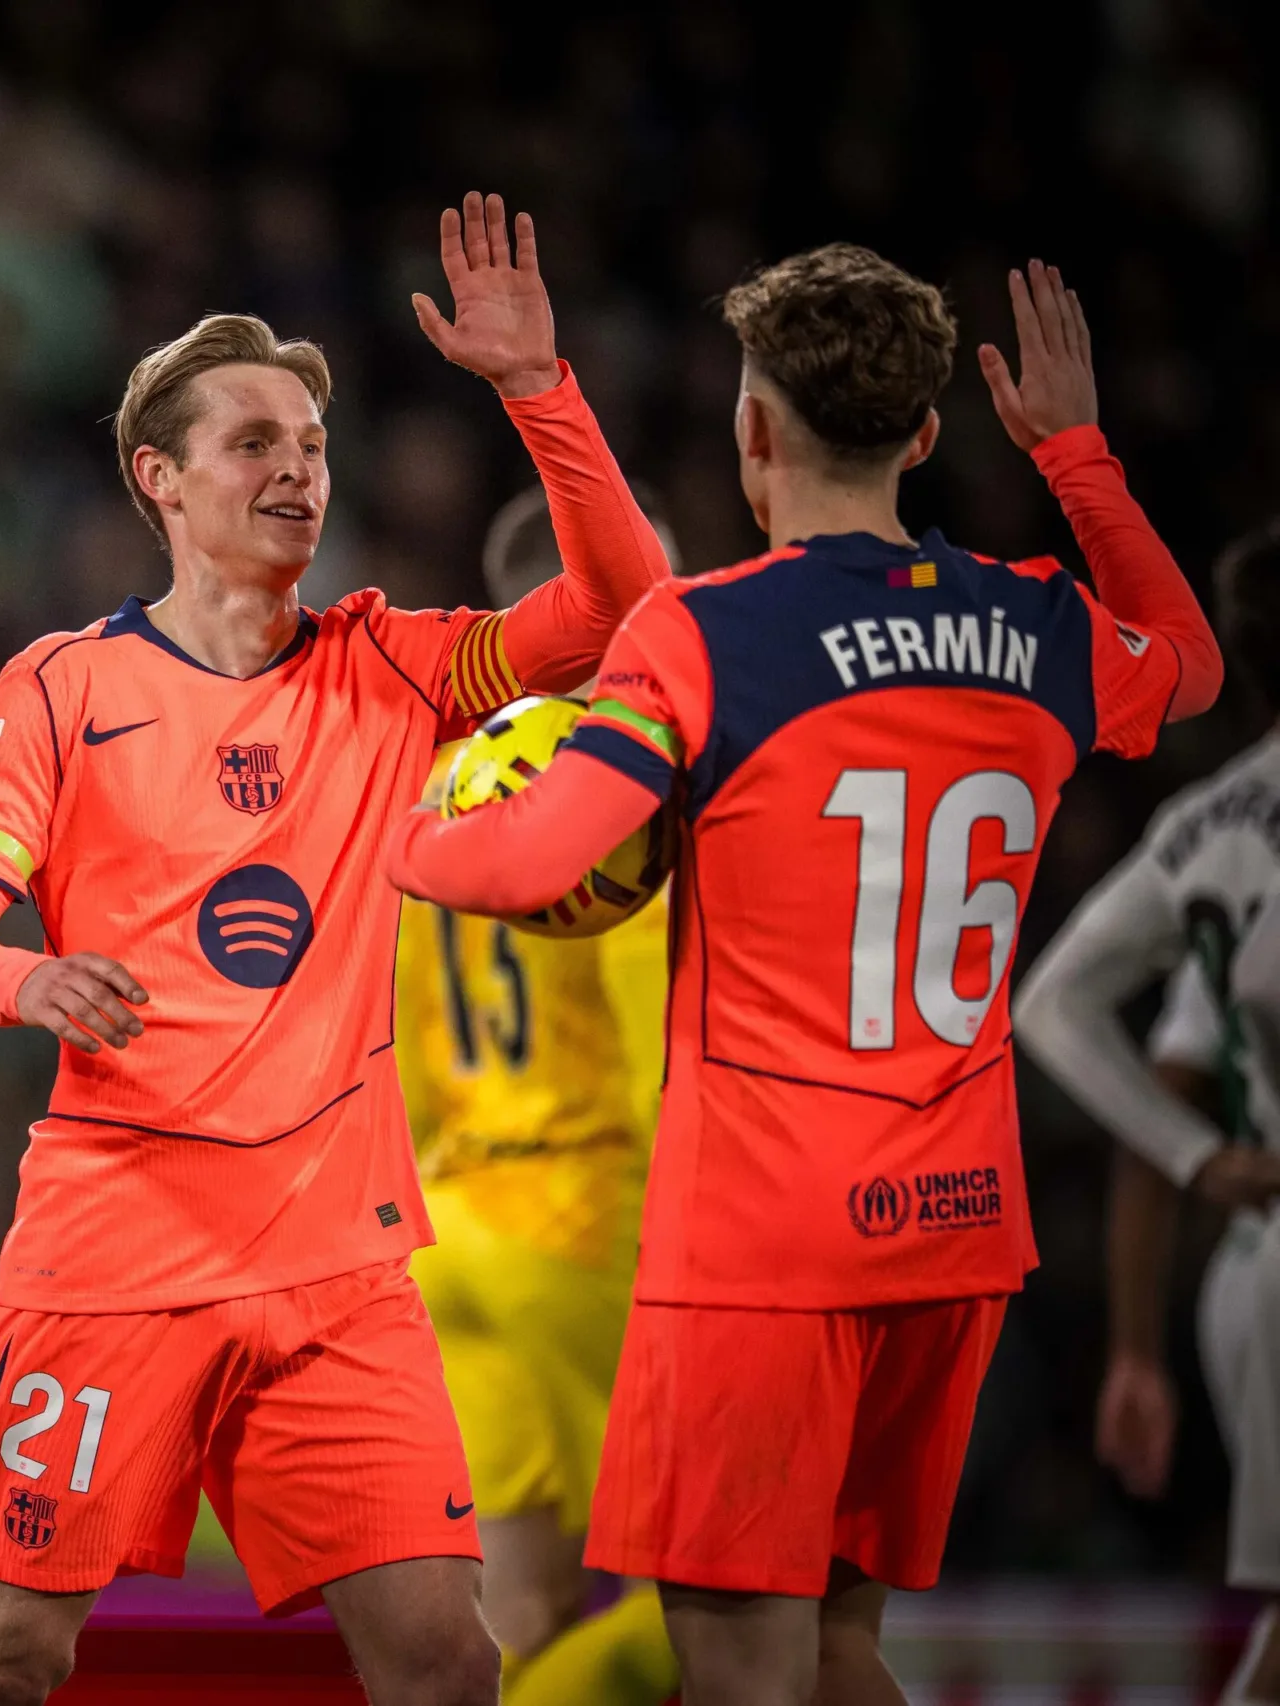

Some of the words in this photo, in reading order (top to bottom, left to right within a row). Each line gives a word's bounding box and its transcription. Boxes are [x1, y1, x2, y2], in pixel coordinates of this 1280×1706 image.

[819, 605, 1038, 692] FERMÍN
[237, 774, 262, 782] FCB
[821, 769, 1037, 1050] 16
[915, 1167, 1000, 1197] UNHCR
[918, 1193, 1001, 1221] ACNUR
[0, 1371, 113, 1494] 21
